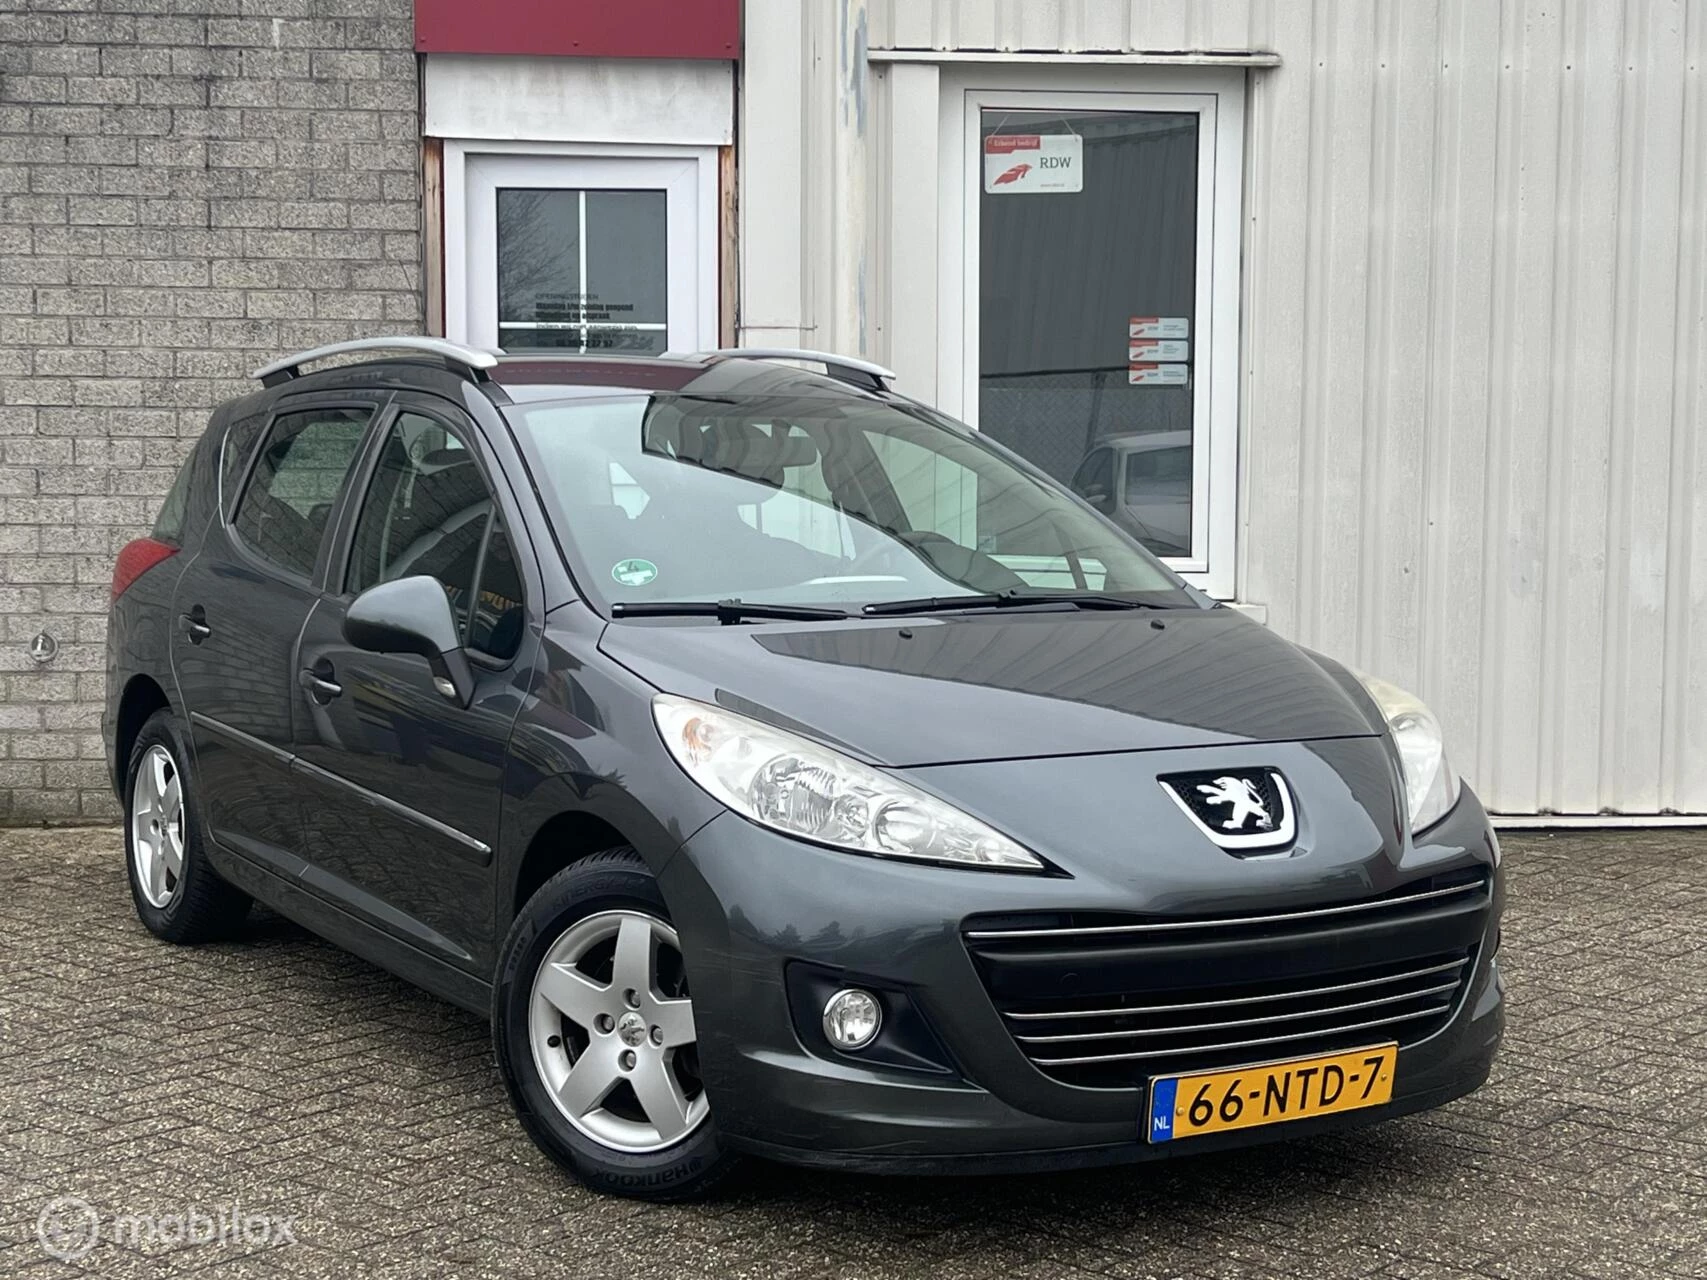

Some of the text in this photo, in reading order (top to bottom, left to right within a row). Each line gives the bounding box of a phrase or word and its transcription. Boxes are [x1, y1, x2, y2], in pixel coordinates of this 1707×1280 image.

[1040, 156, 1072, 169] RDW
[1153, 1056, 1385, 1131] NL 66-NTD-7
